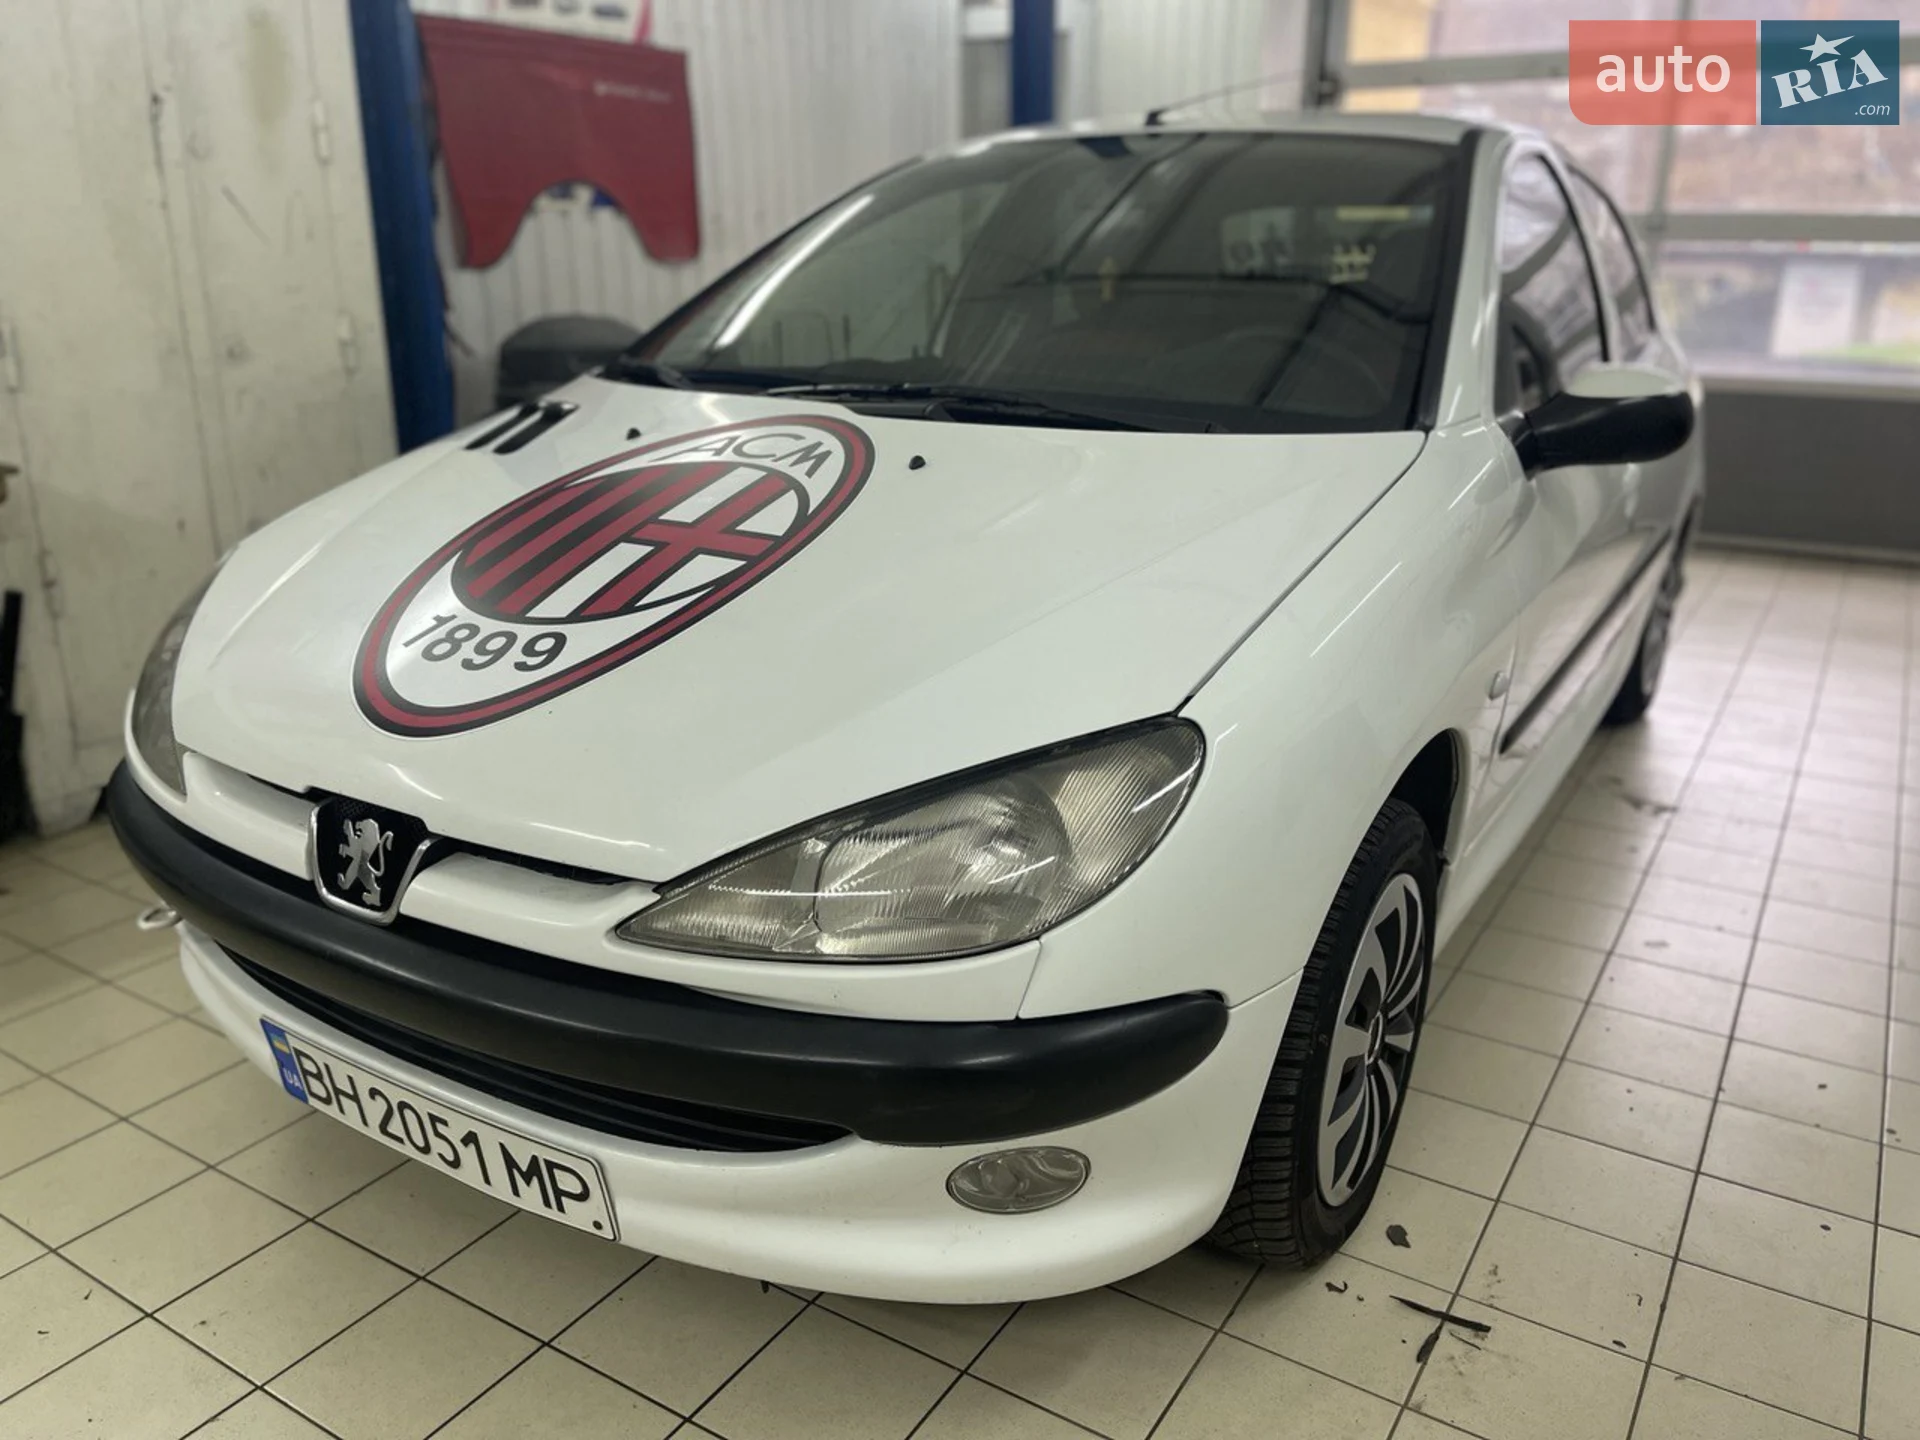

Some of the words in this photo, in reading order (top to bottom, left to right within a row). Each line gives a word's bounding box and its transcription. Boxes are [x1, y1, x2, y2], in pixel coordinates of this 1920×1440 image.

[648, 432, 833, 480] ACM
[401, 613, 568, 673] 1899
[283, 1067, 304, 1091] UA
[293, 1045, 369, 1128] BH
[368, 1086, 493, 1187] 2051
[498, 1140, 590, 1215] MP
